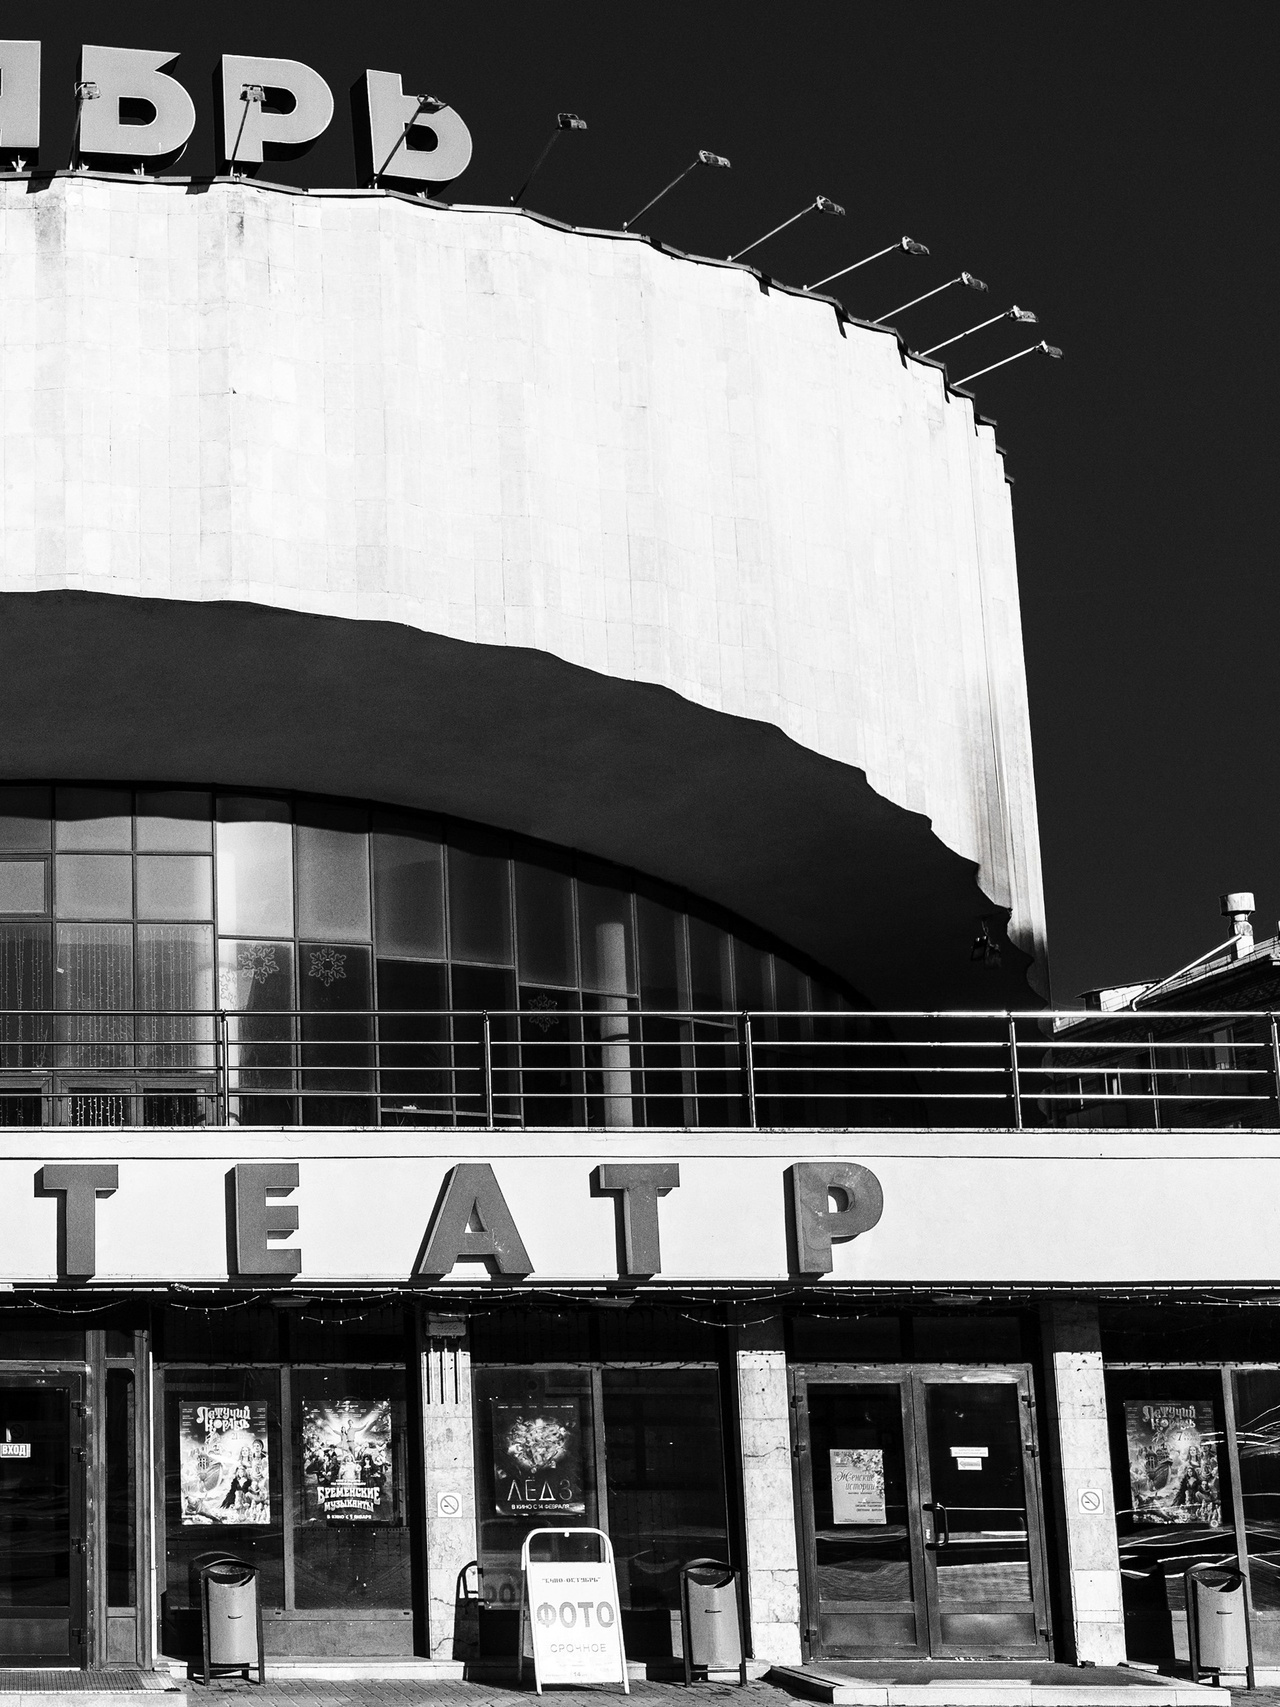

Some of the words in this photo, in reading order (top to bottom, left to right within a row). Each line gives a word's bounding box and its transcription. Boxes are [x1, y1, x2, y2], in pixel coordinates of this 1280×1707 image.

[2, 1445, 26, 1456] ВХОД
[536, 1601, 616, 1628] ФОТО
[550, 1643, 607, 1653] СРОЧНОЕ
